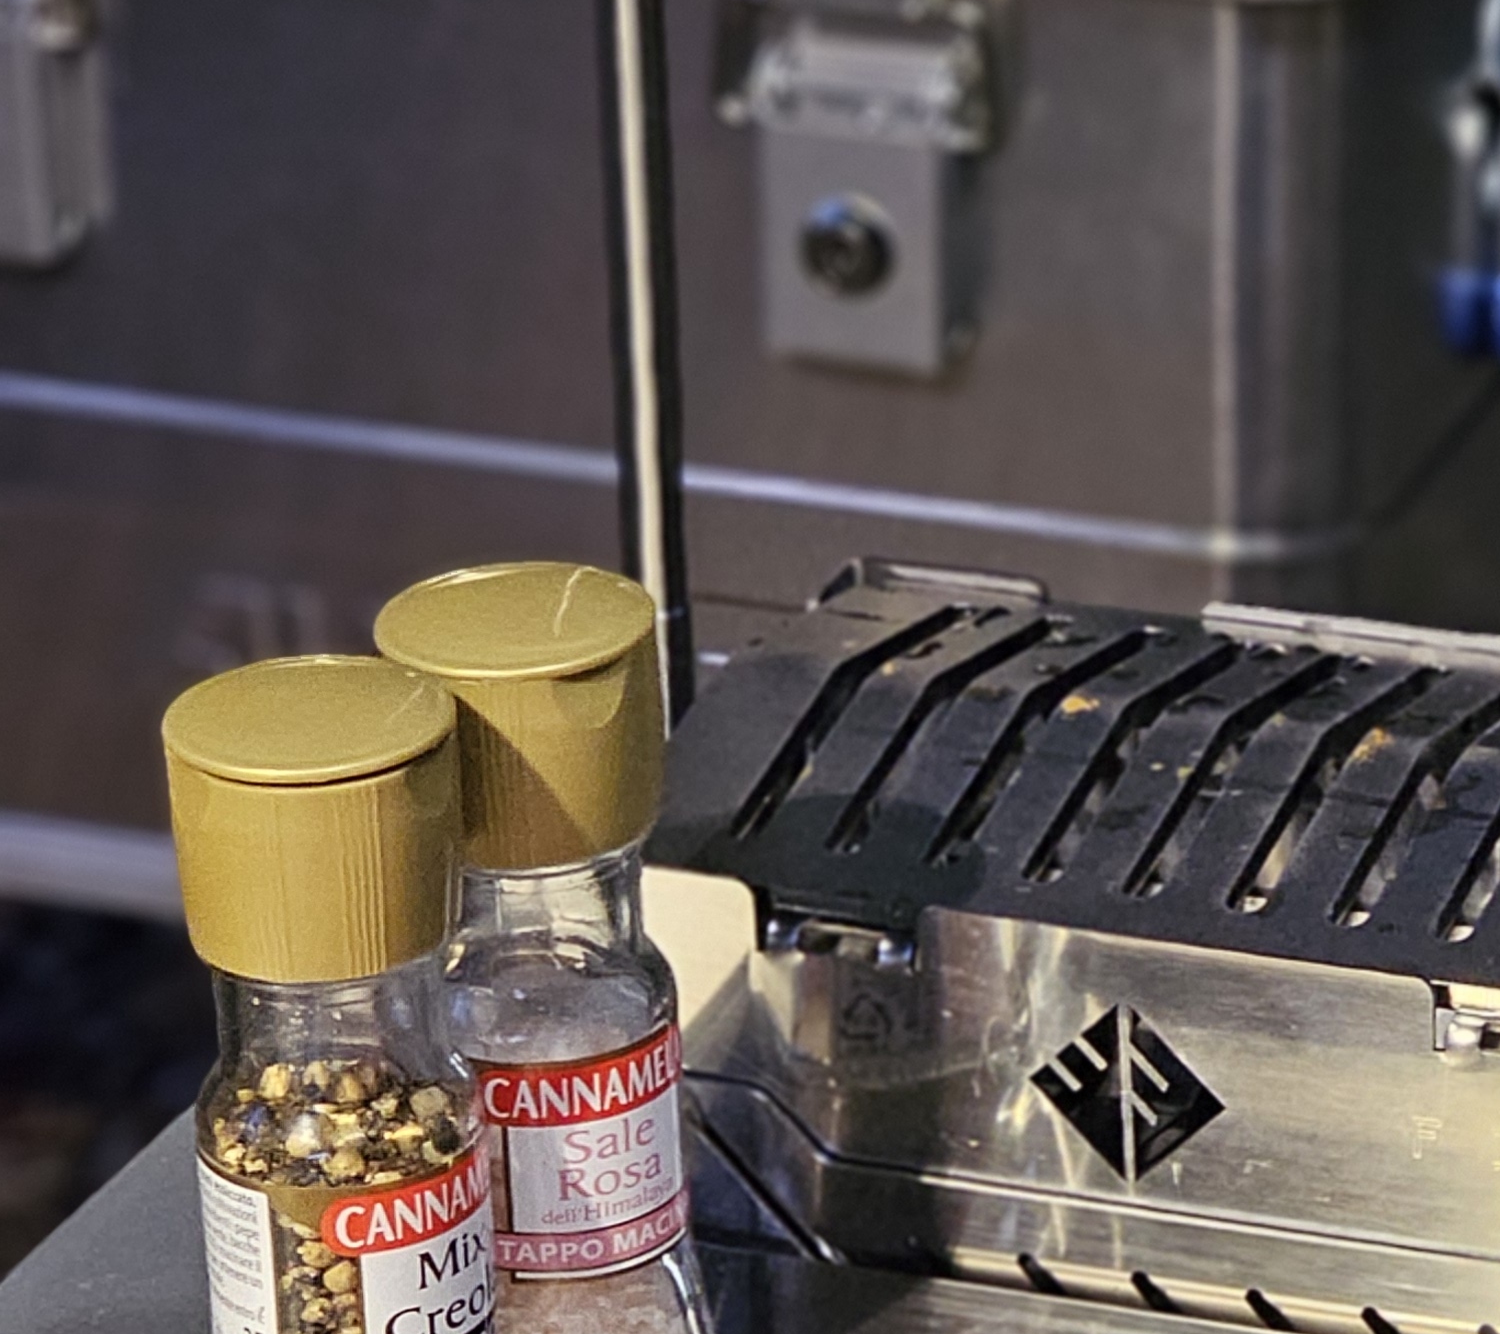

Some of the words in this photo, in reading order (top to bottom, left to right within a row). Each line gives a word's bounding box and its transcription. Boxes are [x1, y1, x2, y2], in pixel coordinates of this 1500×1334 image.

[563, 1117, 655, 1165] Sale
[557, 1152, 662, 1202] Rosa
[418, 1223, 487, 1291] Mix
[497, 1239, 604, 1264] TAPPO
